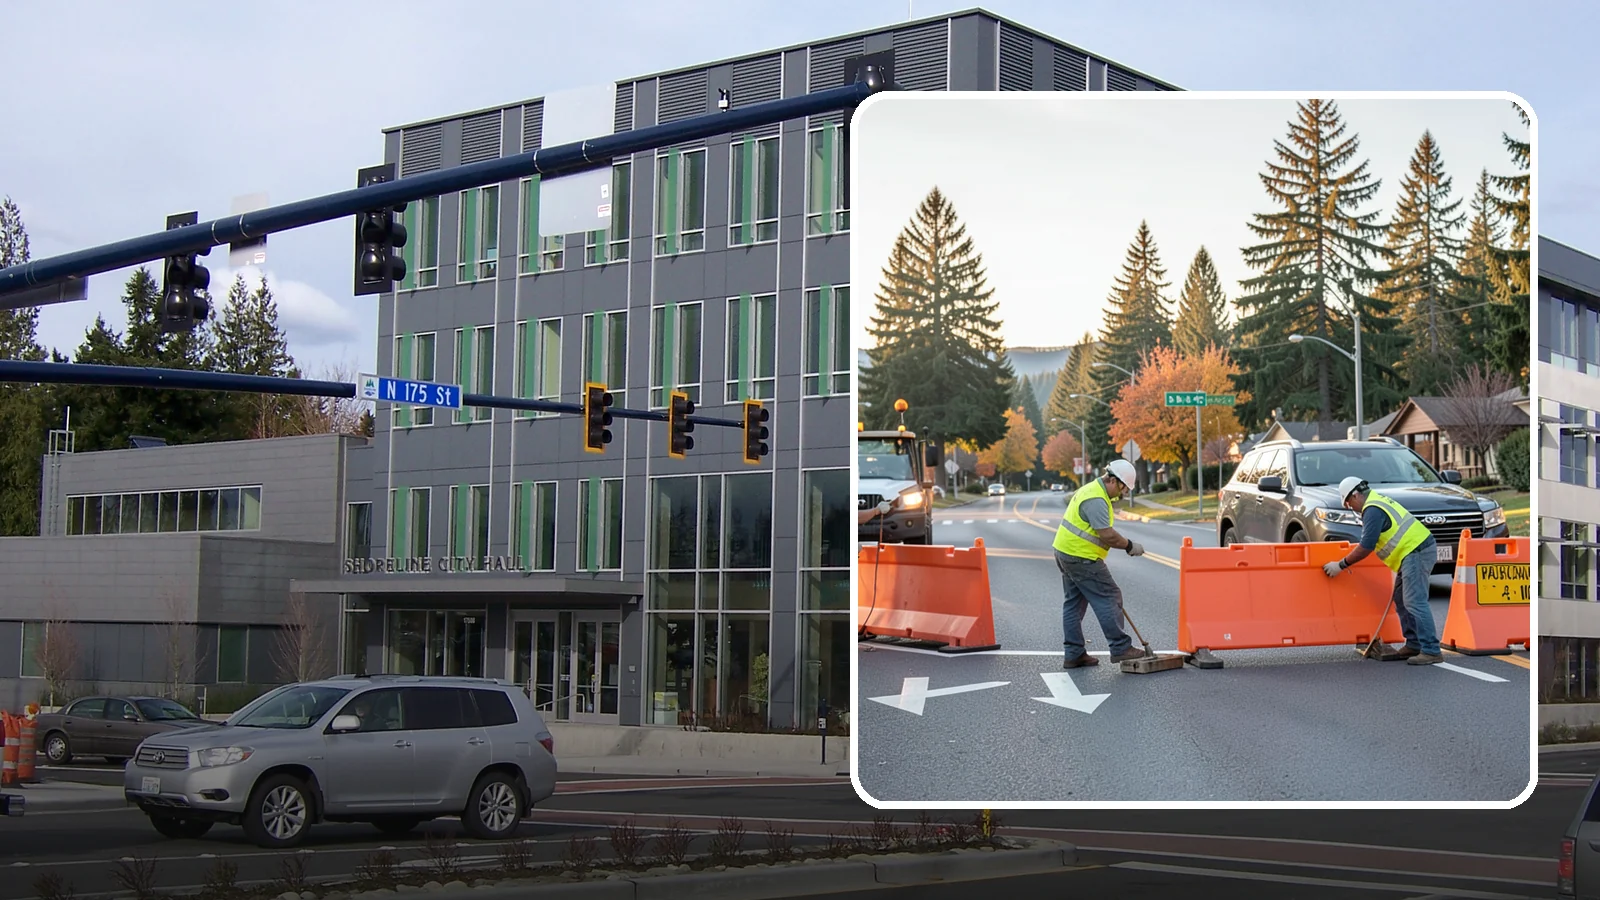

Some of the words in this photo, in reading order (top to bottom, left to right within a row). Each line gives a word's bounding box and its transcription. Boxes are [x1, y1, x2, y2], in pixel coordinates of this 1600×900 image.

[387, 380, 396, 400] N
[405, 382, 427, 403] 175
[436, 386, 451, 406] St
[344, 557, 432, 574] SHORELINE
[438, 556, 476, 572] CITY
[484, 555, 526, 571] HALL
